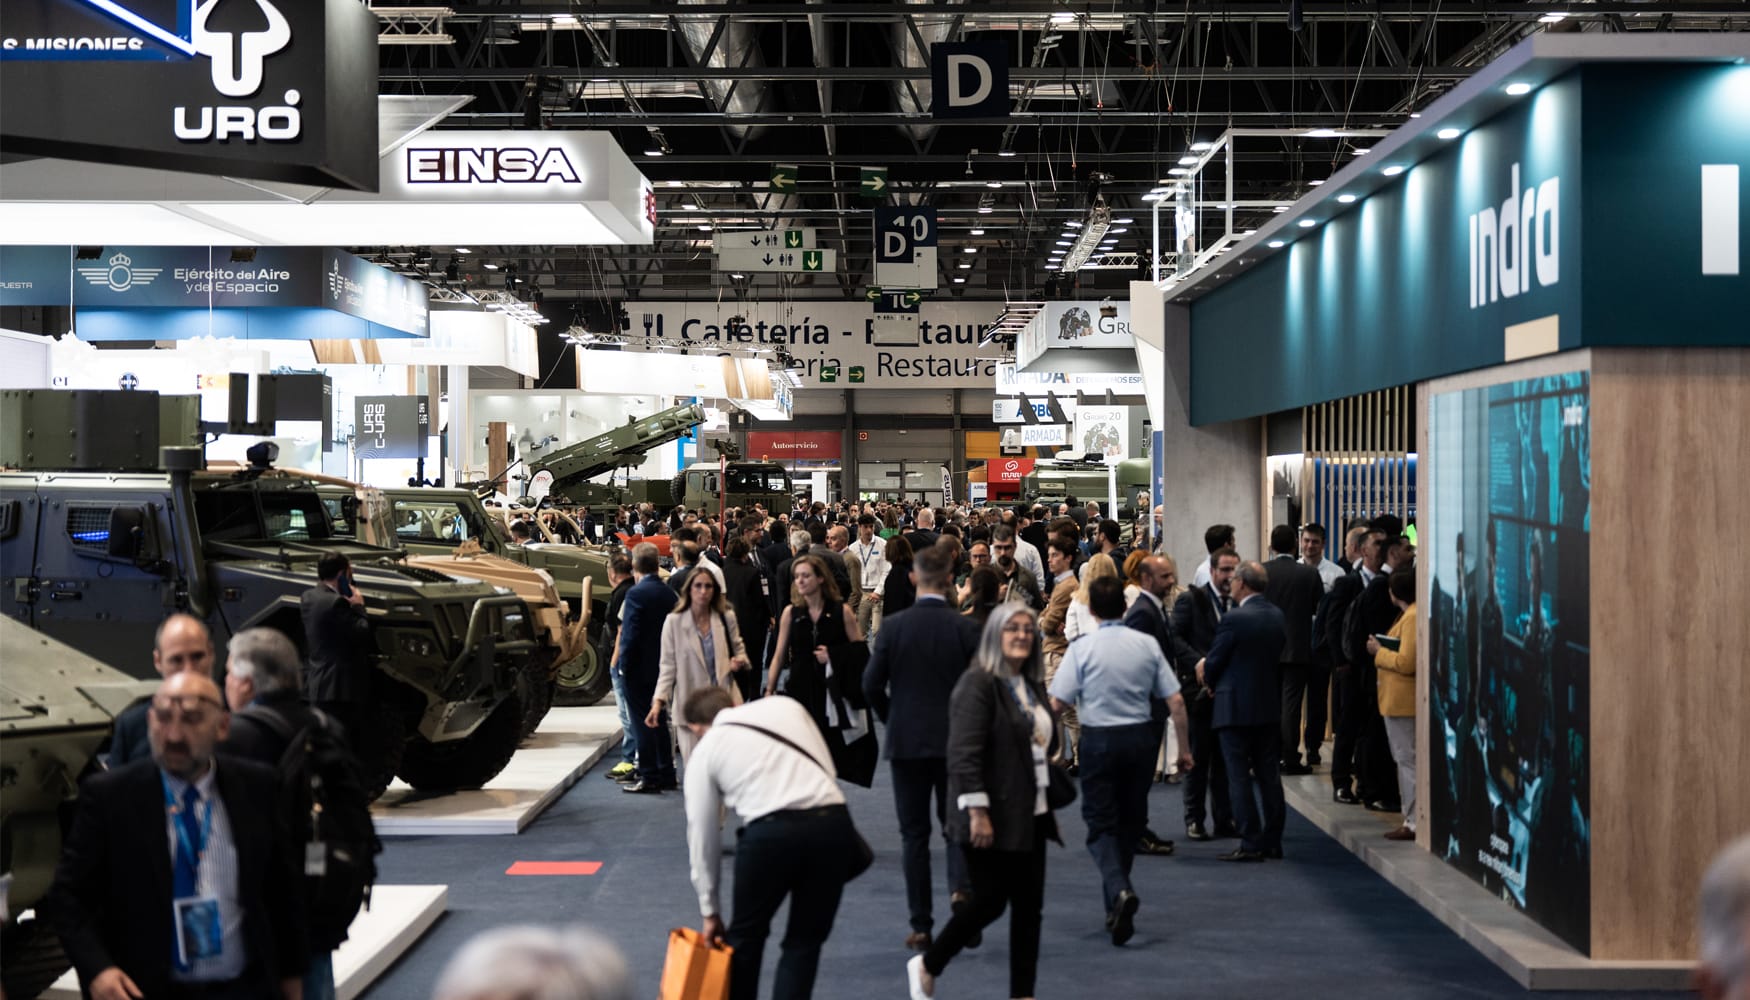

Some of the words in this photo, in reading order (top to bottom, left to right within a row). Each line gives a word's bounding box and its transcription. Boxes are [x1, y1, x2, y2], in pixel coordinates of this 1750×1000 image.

[26, 37, 144, 50] MISIONES
[946, 54, 993, 107] D
[407, 148, 582, 183] EINSA
[884, 231, 907, 257] D
[174, 268, 234, 282] Ejército
[236, 270, 255, 280] del
[257, 268, 290, 280] Aire
[215, 281, 279, 294] Espacio
[681, 317, 829, 344] Cafetería
[364, 404, 374, 433] UAS
[1016, 403, 1060, 418] ARBU
[1109, 412, 1121, 421] 20
[375, 404, 385, 448] C-UAS
[1024, 429, 1062, 442] ARMADA
